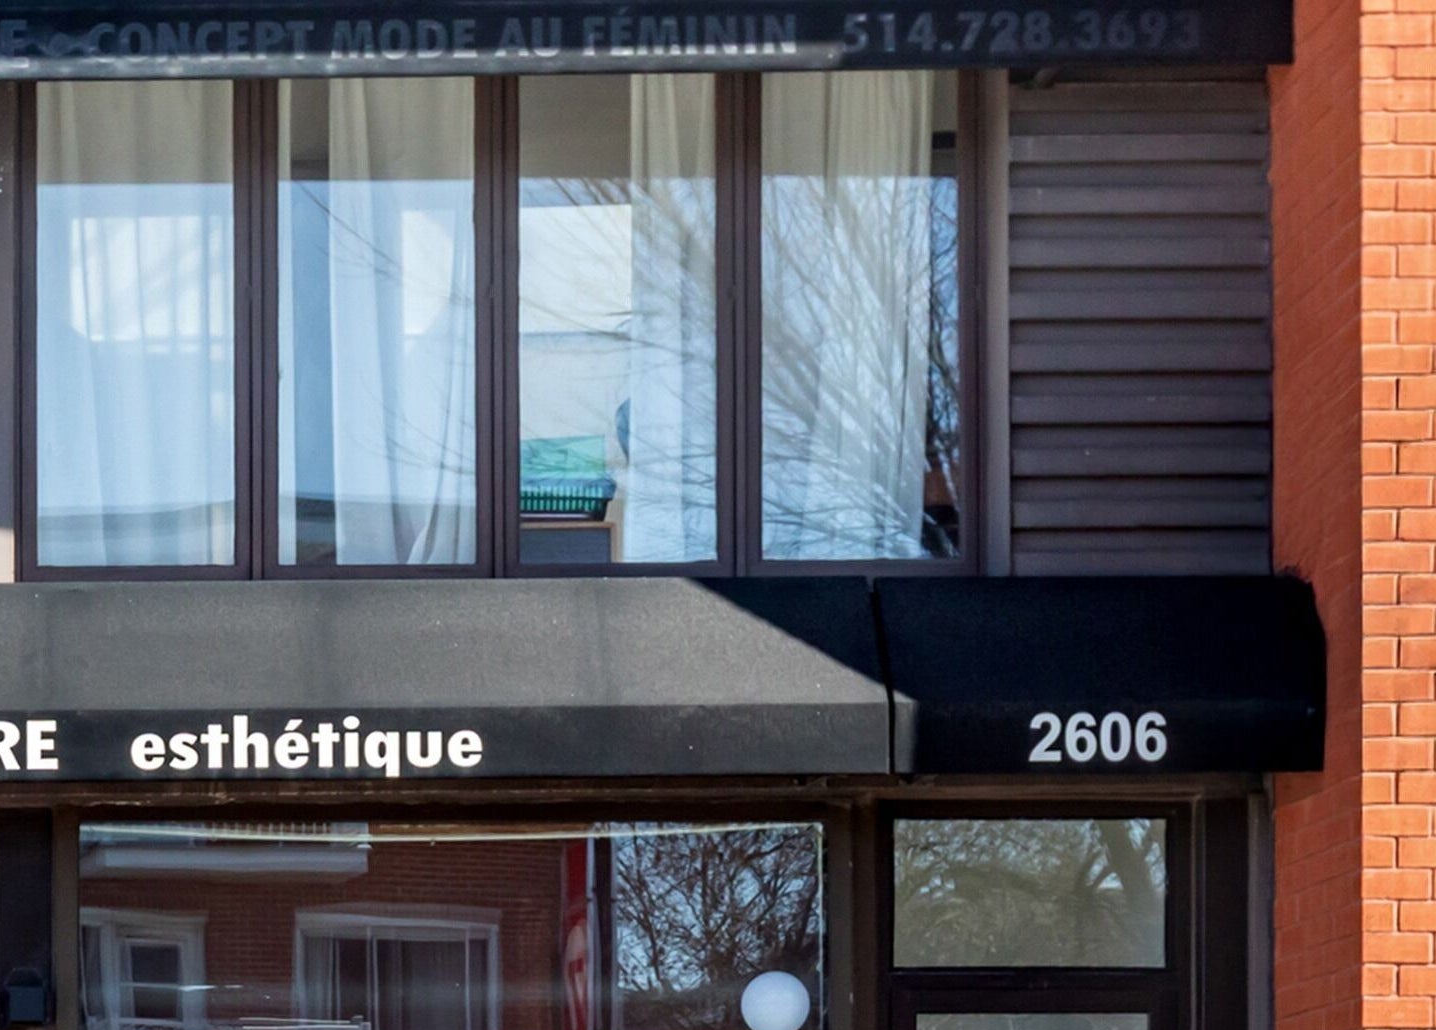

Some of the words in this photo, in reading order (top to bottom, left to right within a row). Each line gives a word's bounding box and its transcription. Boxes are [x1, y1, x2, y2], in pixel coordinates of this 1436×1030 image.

[87, 20, 315, 64] CONCEPT
[330, 16, 477, 60] MODE
[494, 16, 563, 58] AU
[582, 5, 798, 57] FÉMININ
[842, 10, 1201, 54] 514.728.3693
[130, 714, 483, 778] esthétique
[1028, 711, 1168, 763] 2606
